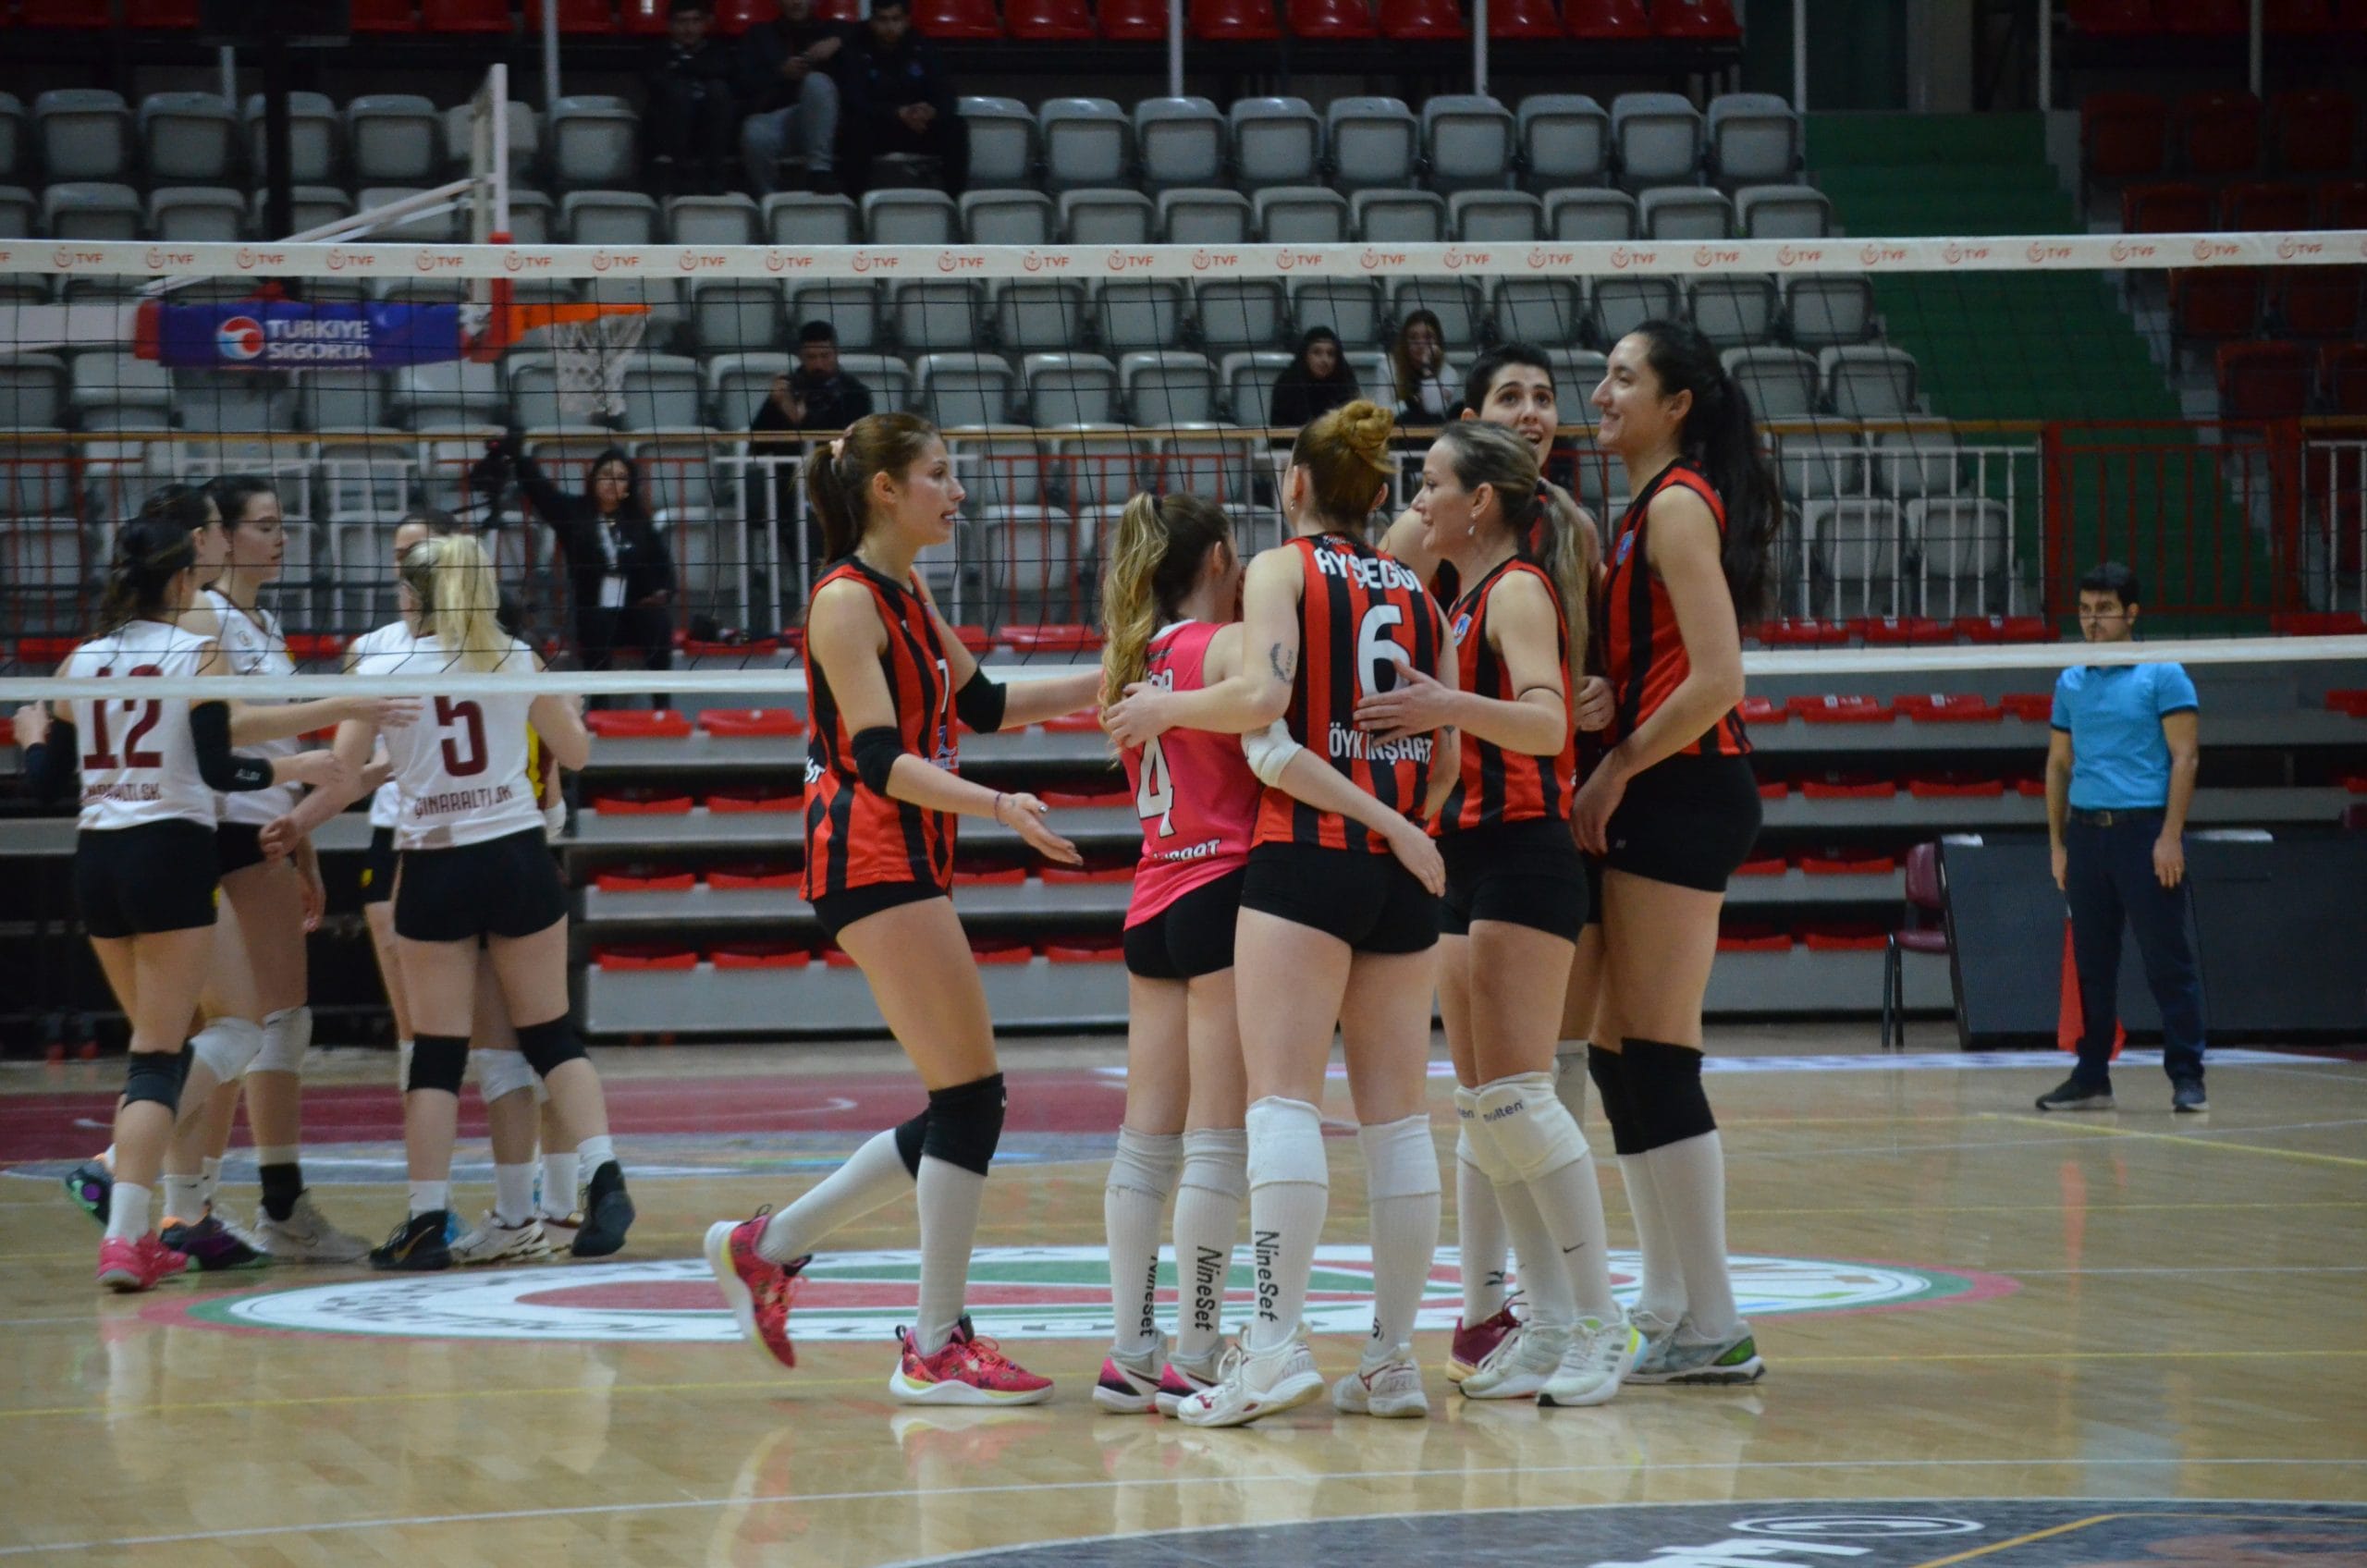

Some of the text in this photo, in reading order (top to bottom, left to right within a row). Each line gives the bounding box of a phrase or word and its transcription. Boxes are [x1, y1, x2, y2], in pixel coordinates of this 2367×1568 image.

[75, 251, 103, 263] TVF
[166, 252, 193, 263] TVF
[257, 253, 285, 264] TVF
[347, 255, 374, 265] TVF
[435, 256, 462, 266] TVF
[525, 256, 552, 267] TVF
[612, 255, 640, 266] TVF
[697, 255, 725, 266] TVF
[785, 256, 813, 266] TVF
[872, 256, 900, 267] TVF
[957, 256, 985, 267] TVF
[1043, 256, 1071, 267] TVF
[1126, 254, 1154, 266] TVF
[1210, 254, 1238, 266] TVF
[1294, 254, 1322, 265] TVF
[1379, 253, 1406, 265] TVF
[1464, 253, 1490, 264] TVF
[1545, 253, 1573, 264] TVF
[1628, 252, 1656, 264] TVF
[1357, 604, 1411, 700] 6
[83, 664, 164, 769] 12
[435, 695, 488, 777] 5
[1329, 721, 1364, 760] ÖYK
[1136, 735, 1176, 839] 4
[1195, 1245, 1222, 1332] NineSet
[1256, 1231, 1281, 1322] NineSet
